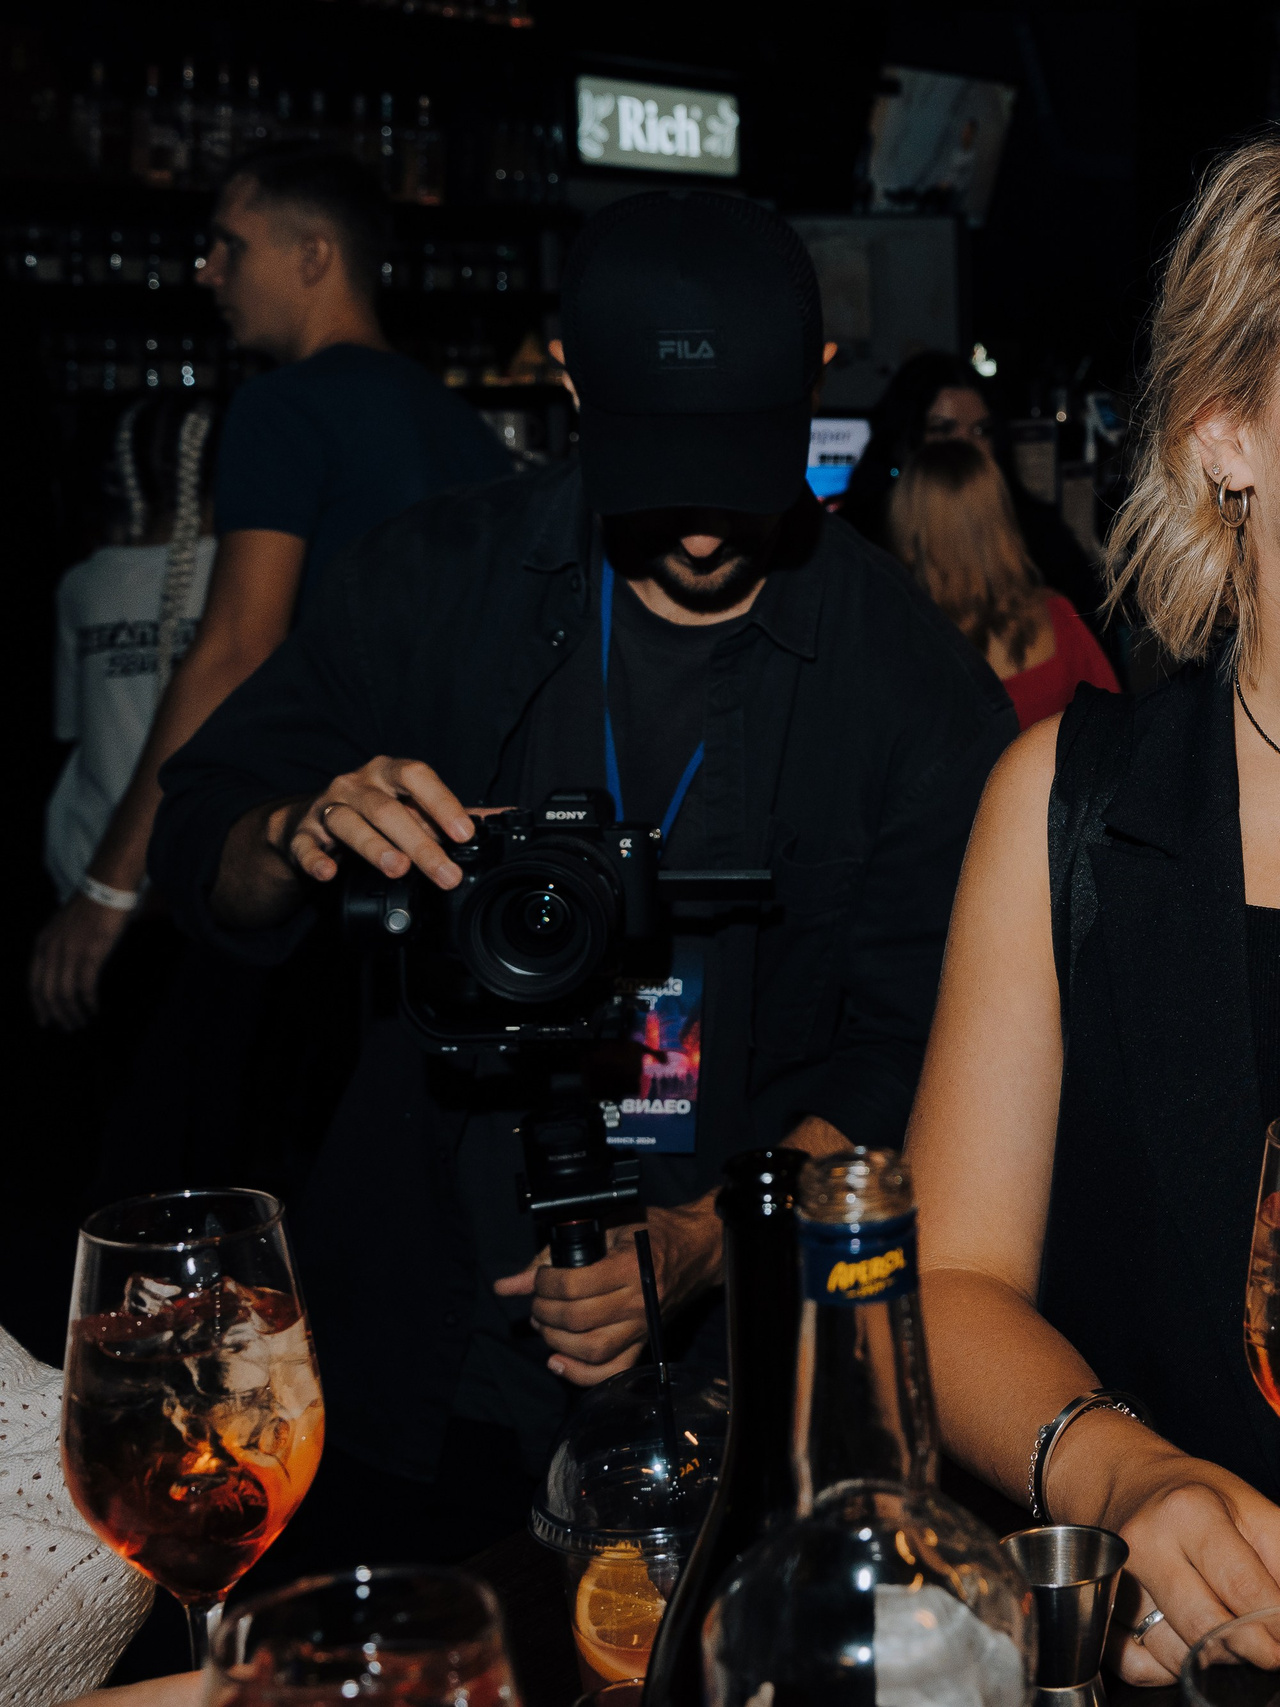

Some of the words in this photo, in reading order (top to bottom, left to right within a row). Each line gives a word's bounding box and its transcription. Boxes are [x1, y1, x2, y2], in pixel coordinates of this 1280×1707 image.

[617, 95, 700, 158] Rich
[658, 339, 715, 359] FILA
[545, 810, 588, 820] SONY
